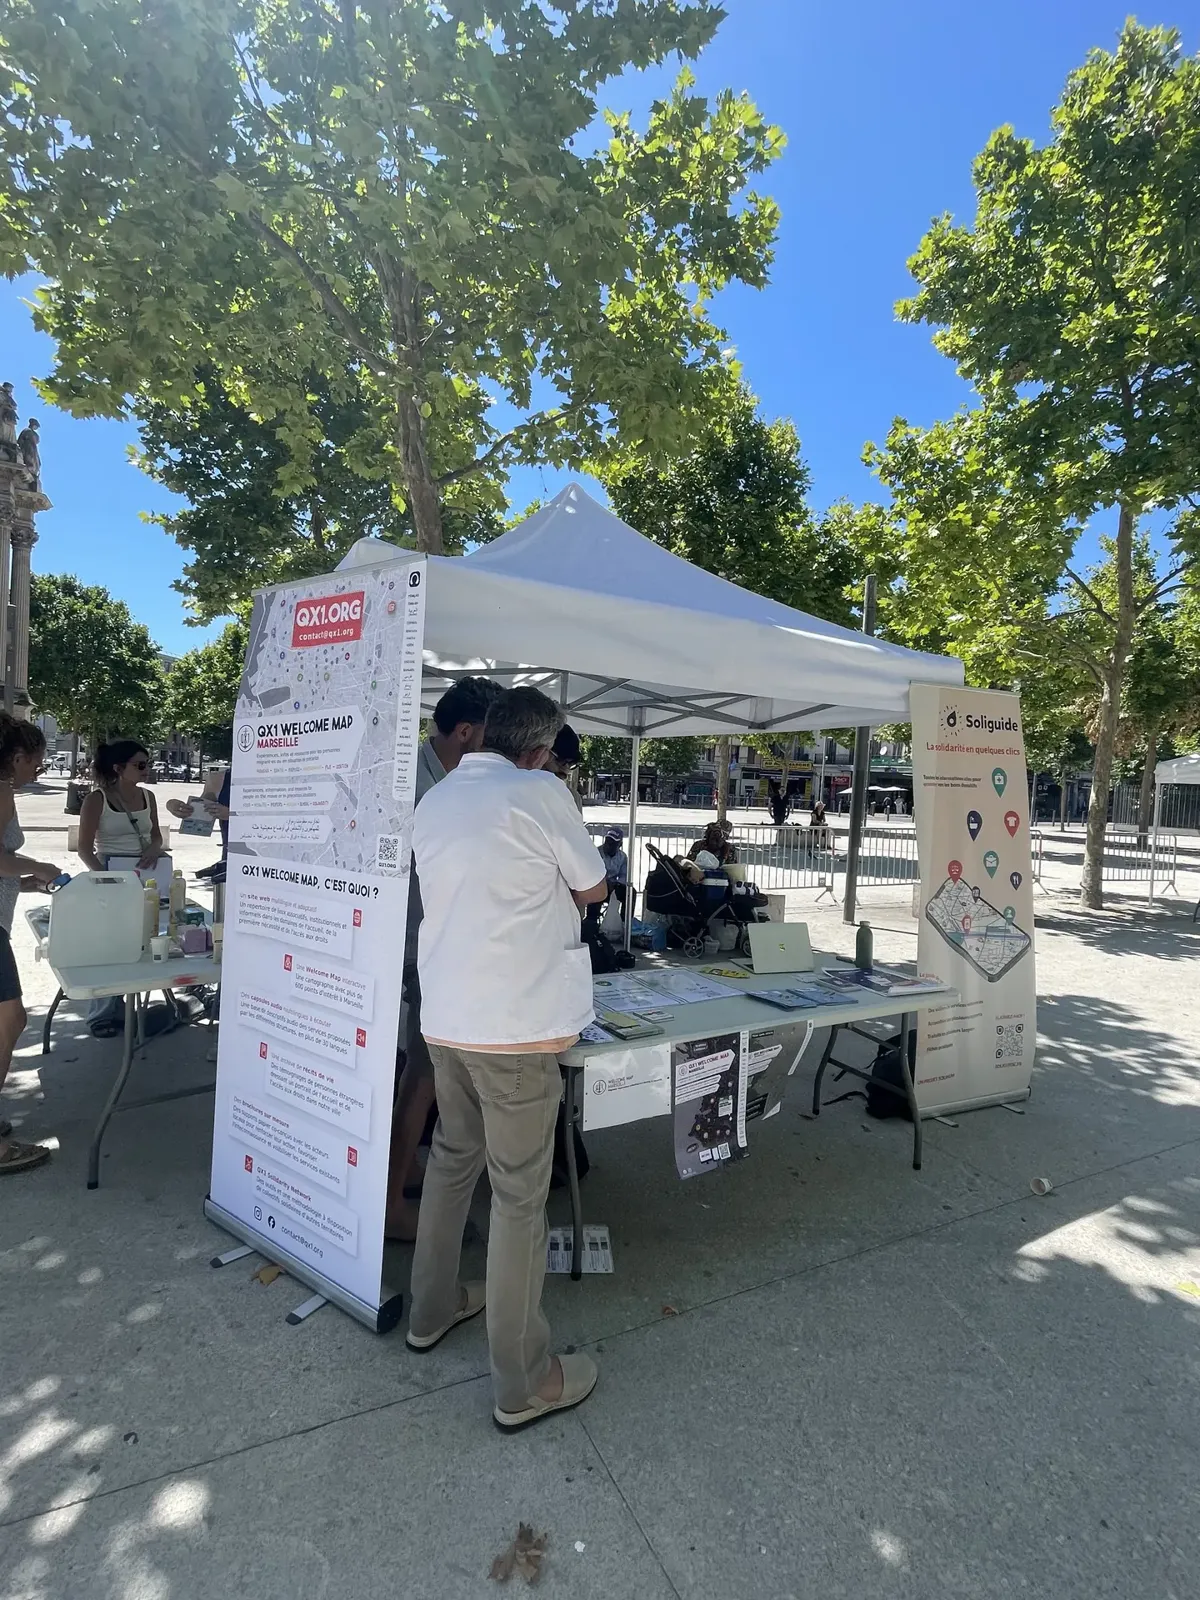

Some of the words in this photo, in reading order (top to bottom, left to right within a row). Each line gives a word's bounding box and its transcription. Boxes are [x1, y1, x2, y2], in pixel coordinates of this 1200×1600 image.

[296, 600, 361, 627] QX1.ORG
[299, 628, 354, 641] contact@qx1.org
[258, 725, 278, 737] QX1
[280, 718, 329, 736] WELCOME
[332, 715, 353, 730] MAP
[966, 714, 1018, 733] Soliguide
[257, 737, 298, 748] MARSEILLE
[926, 742, 934, 750] La
[935, 742, 965, 752] solidarité
[975, 746, 1004, 755] quelques
[1006, 747, 1020, 756] clics
[242, 865, 259, 876] QX1
[262, 868, 300, 884] WELCOME
[300, 874, 320, 889] MAP,
[324, 878, 346, 893] C'EST
[348, 884, 370, 898] QUOI
[373, 888, 379, 898] ?
[239, 909, 261, 918] informels
[305, 923, 324, 934] l'accueil,
[239, 918, 260, 926] première
[261, 921, 280, 931] nécessité
[291, 929, 305, 938] l'accès
[314, 935, 328, 943] droits
[310, 917, 341, 929] institutionnels
[296, 973, 304, 981] Une
[305, 977, 334, 991] cartographie
[346, 990, 356, 998] plus
[306, 966, 329, 978] Welcome
[330, 973, 341, 982] Map
[241, 992, 250, 1000] Des
[251, 995, 270, 1006] capsules
[270, 1002, 282, 1011] audio
[295, 982, 303, 990] 600
[304, 986, 318, 995] points
[343, 997, 364, 1010] Marseille
[240, 1001, 250, 1009] Une
[299, 1022, 307, 1030] des
[308, 1026, 327, 1038] services
[276, 1023, 297, 1036] structures,
[305, 1034, 314, 1042] plus
[322, 1039, 328, 1047] 30
[329, 1042, 348, 1055] langues
[270, 1062, 278, 1070] Des
[307, 1078, 313, 1086] de
[314, 1082, 338, 1096] personnes
[303, 1067, 317, 1077] récits
[326, 1076, 335, 1084] vie
[293, 1090, 306, 1101] droits
[306, 1096, 317, 1105] dans
[318, 1101, 331, 1112] notre
[294, 1082, 312, 1094] portrait
[345, 1104, 351, 1112] de
[242, 1100, 263, 1115] brochures
[272, 1116, 289, 1128] mesure
[233, 1105, 241, 1113] Des
[293, 1137, 303, 1147] avec
[312, 1147, 329, 1159] acteurs
[300, 1158, 318, 1172] services
[319, 1168, 340, 1184] existants
[267, 1172, 290, 1190] Solidarity
[290, 1186, 312, 1202] Network
[256, 1176, 264, 1185] Des
[282, 1192, 291, 1200] une
[326, 1217, 353, 1237] disposition
[256, 1184, 262, 1193] de
[262, 1188, 280, 1203] collectifs
[281, 1199, 301, 1216] solidaires
[302, 1211, 321, 1228] d'autres
[321, 1222, 344, 1242] territoires
[281, 1226, 324, 1258] contact@qx1.org
